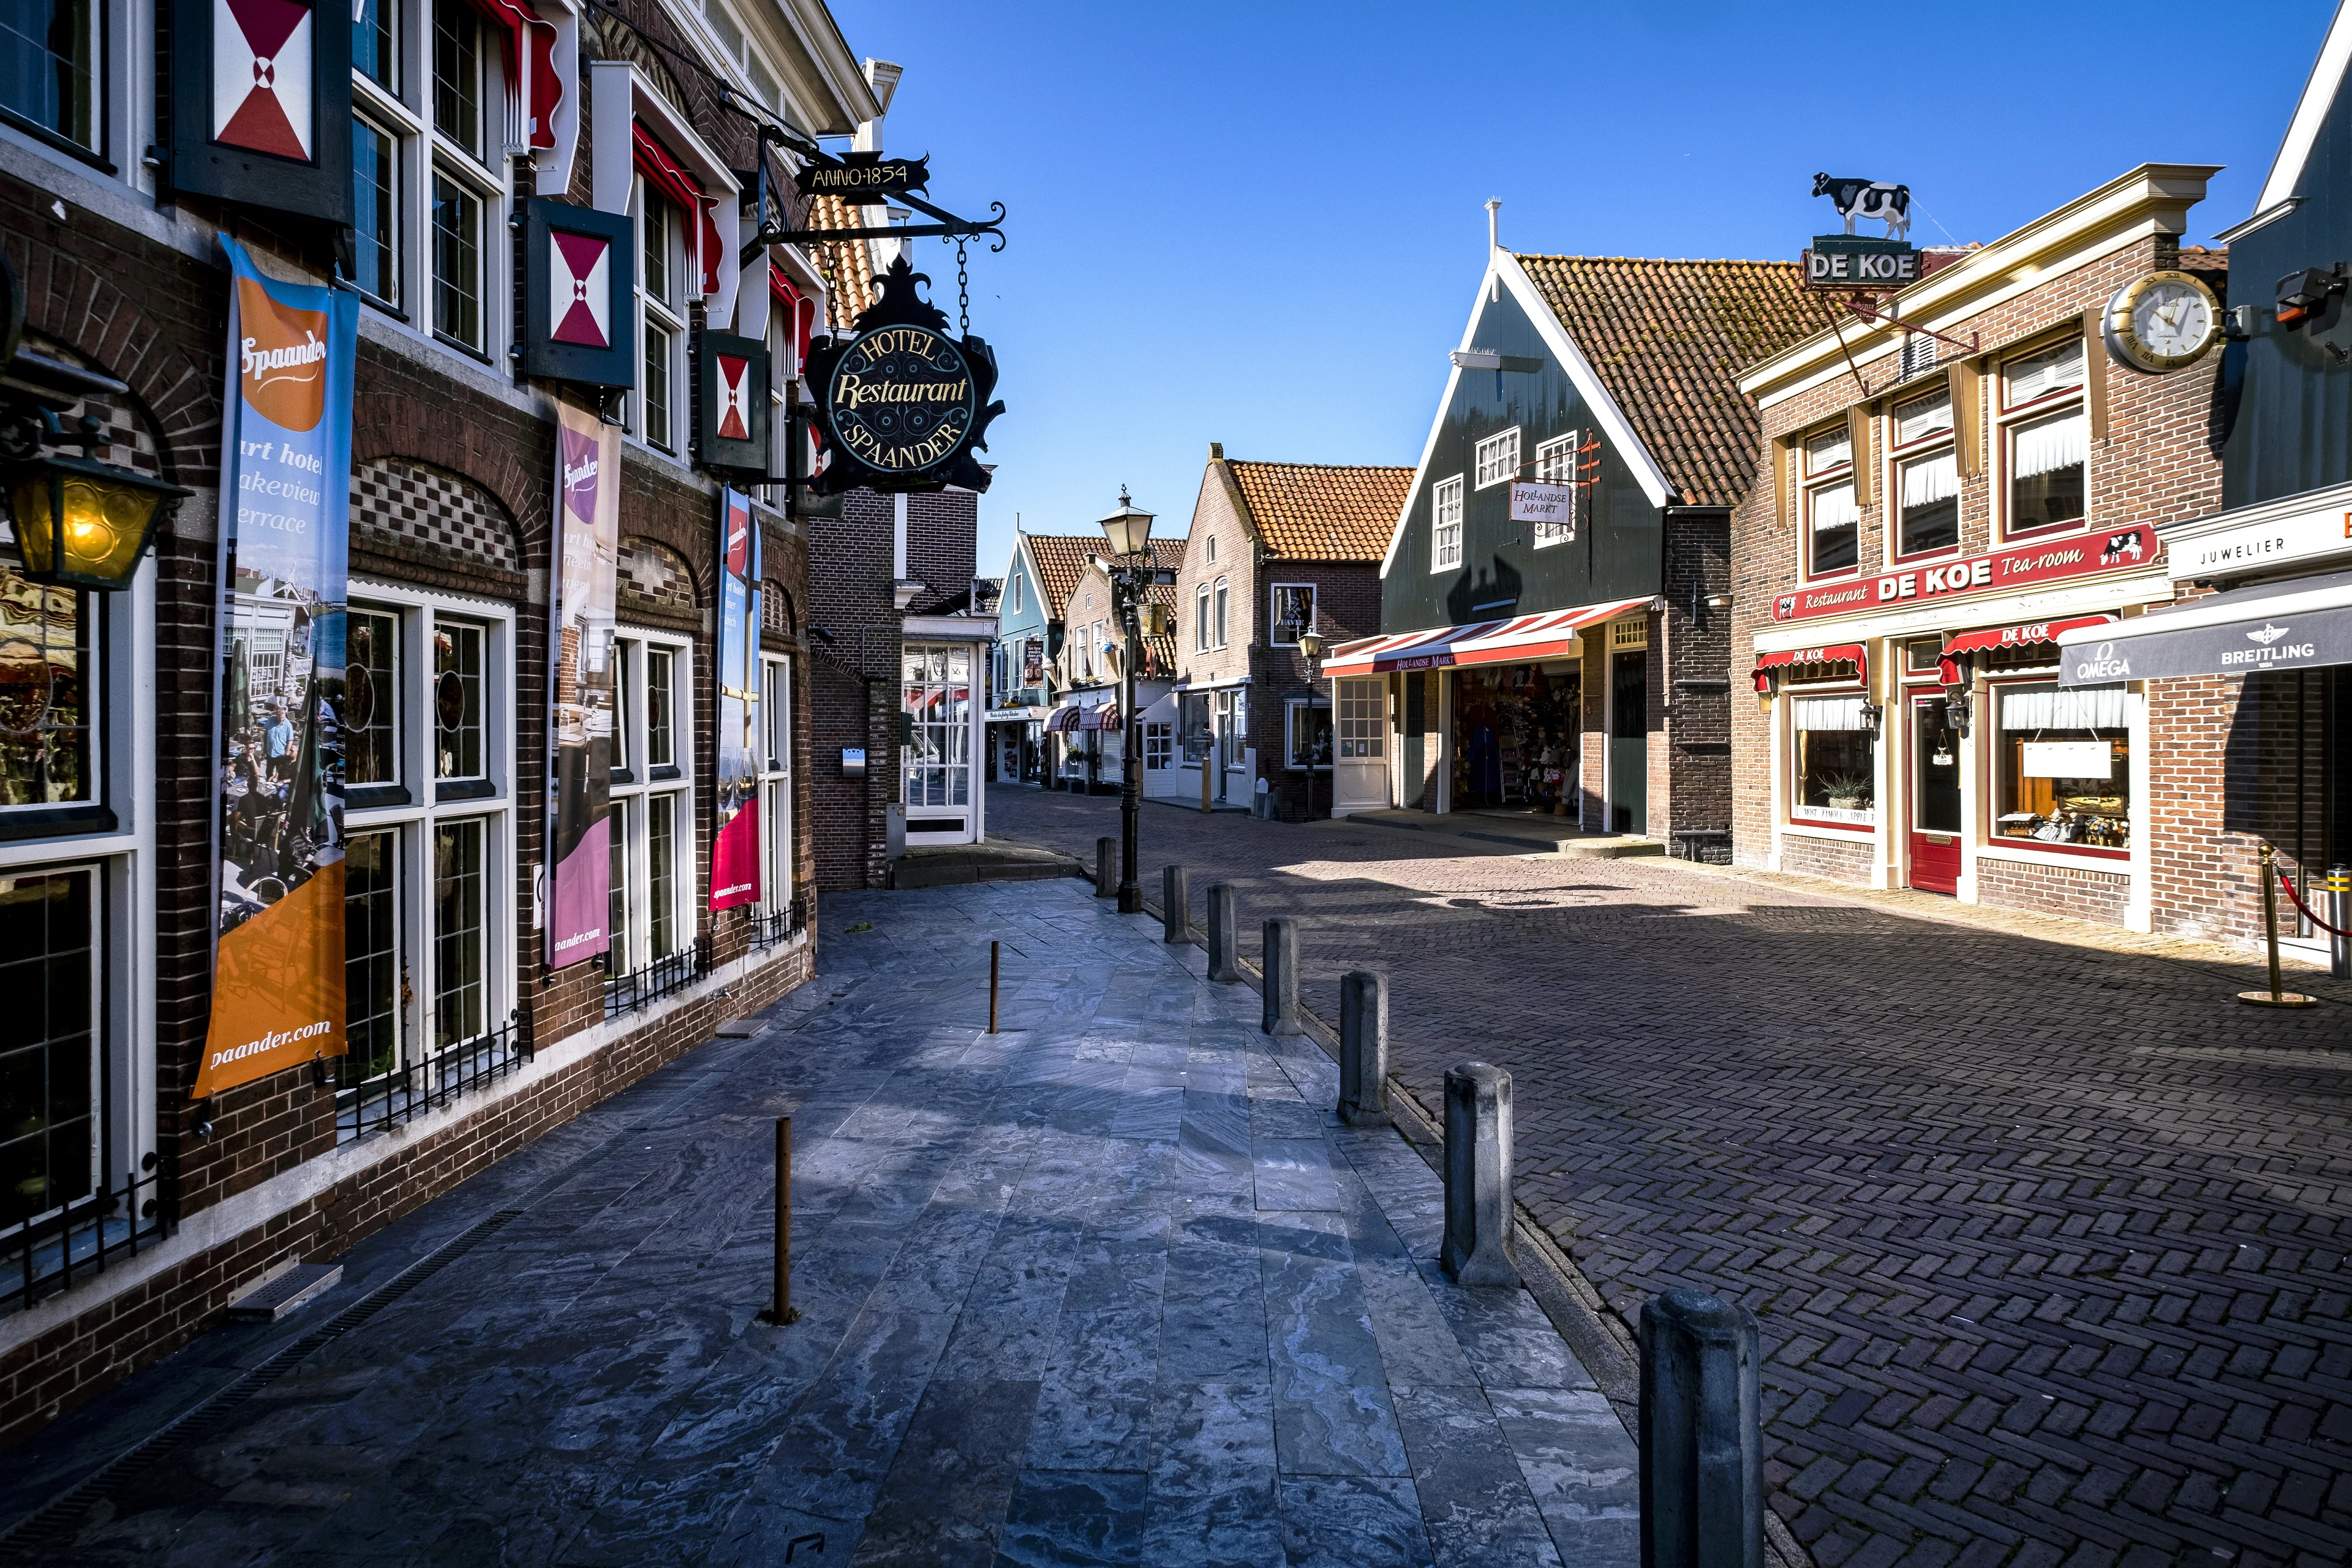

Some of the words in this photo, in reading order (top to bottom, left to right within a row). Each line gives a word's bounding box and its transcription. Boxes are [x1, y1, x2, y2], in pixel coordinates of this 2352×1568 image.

[1811, 254, 1849, 278] DE
[1858, 254, 1917, 279] KOE
[2142, 276, 2157, 286] XI
[1856, 301, 1875, 309] Since
[242, 330, 326, 380] Spaander
[859, 329, 938, 363] HOTEL
[835, 374, 968, 409] Restaurant
[842, 423, 962, 469] SPAANDER
[280, 443, 323, 476] hotel
[239, 471, 320, 506] akeview
[1513, 489, 1567, 503] HOLLANDSE
[1522, 503, 1558, 514] MARKT
[238, 508, 306, 534] errace
[2200, 538, 2285, 565] JUWELIER
[1804, 584, 1869, 610] Restaurant
[1878, 572, 1917, 601] DE
[1925, 559, 1993, 593] KOE
[2001, 548, 2084, 576] Tea-room
[2001, 628, 2019, 642] DE
[2021, 624, 2049, 640] KOE
[1396, 657, 1430, 671] HOLLANDSE
[1431, 655, 1454, 668] MARKT
[1792, 650, 1804, 662] DE
[1806, 648, 1825, 660] KOE
[2221, 643, 2315, 665] BREITLING
[2076, 658, 2130, 680] OMEGA
[1804, 808, 1817, 816] MOST
[554, 928, 600, 952] aander.com
[210, 1020, 331, 1070] paander.com
